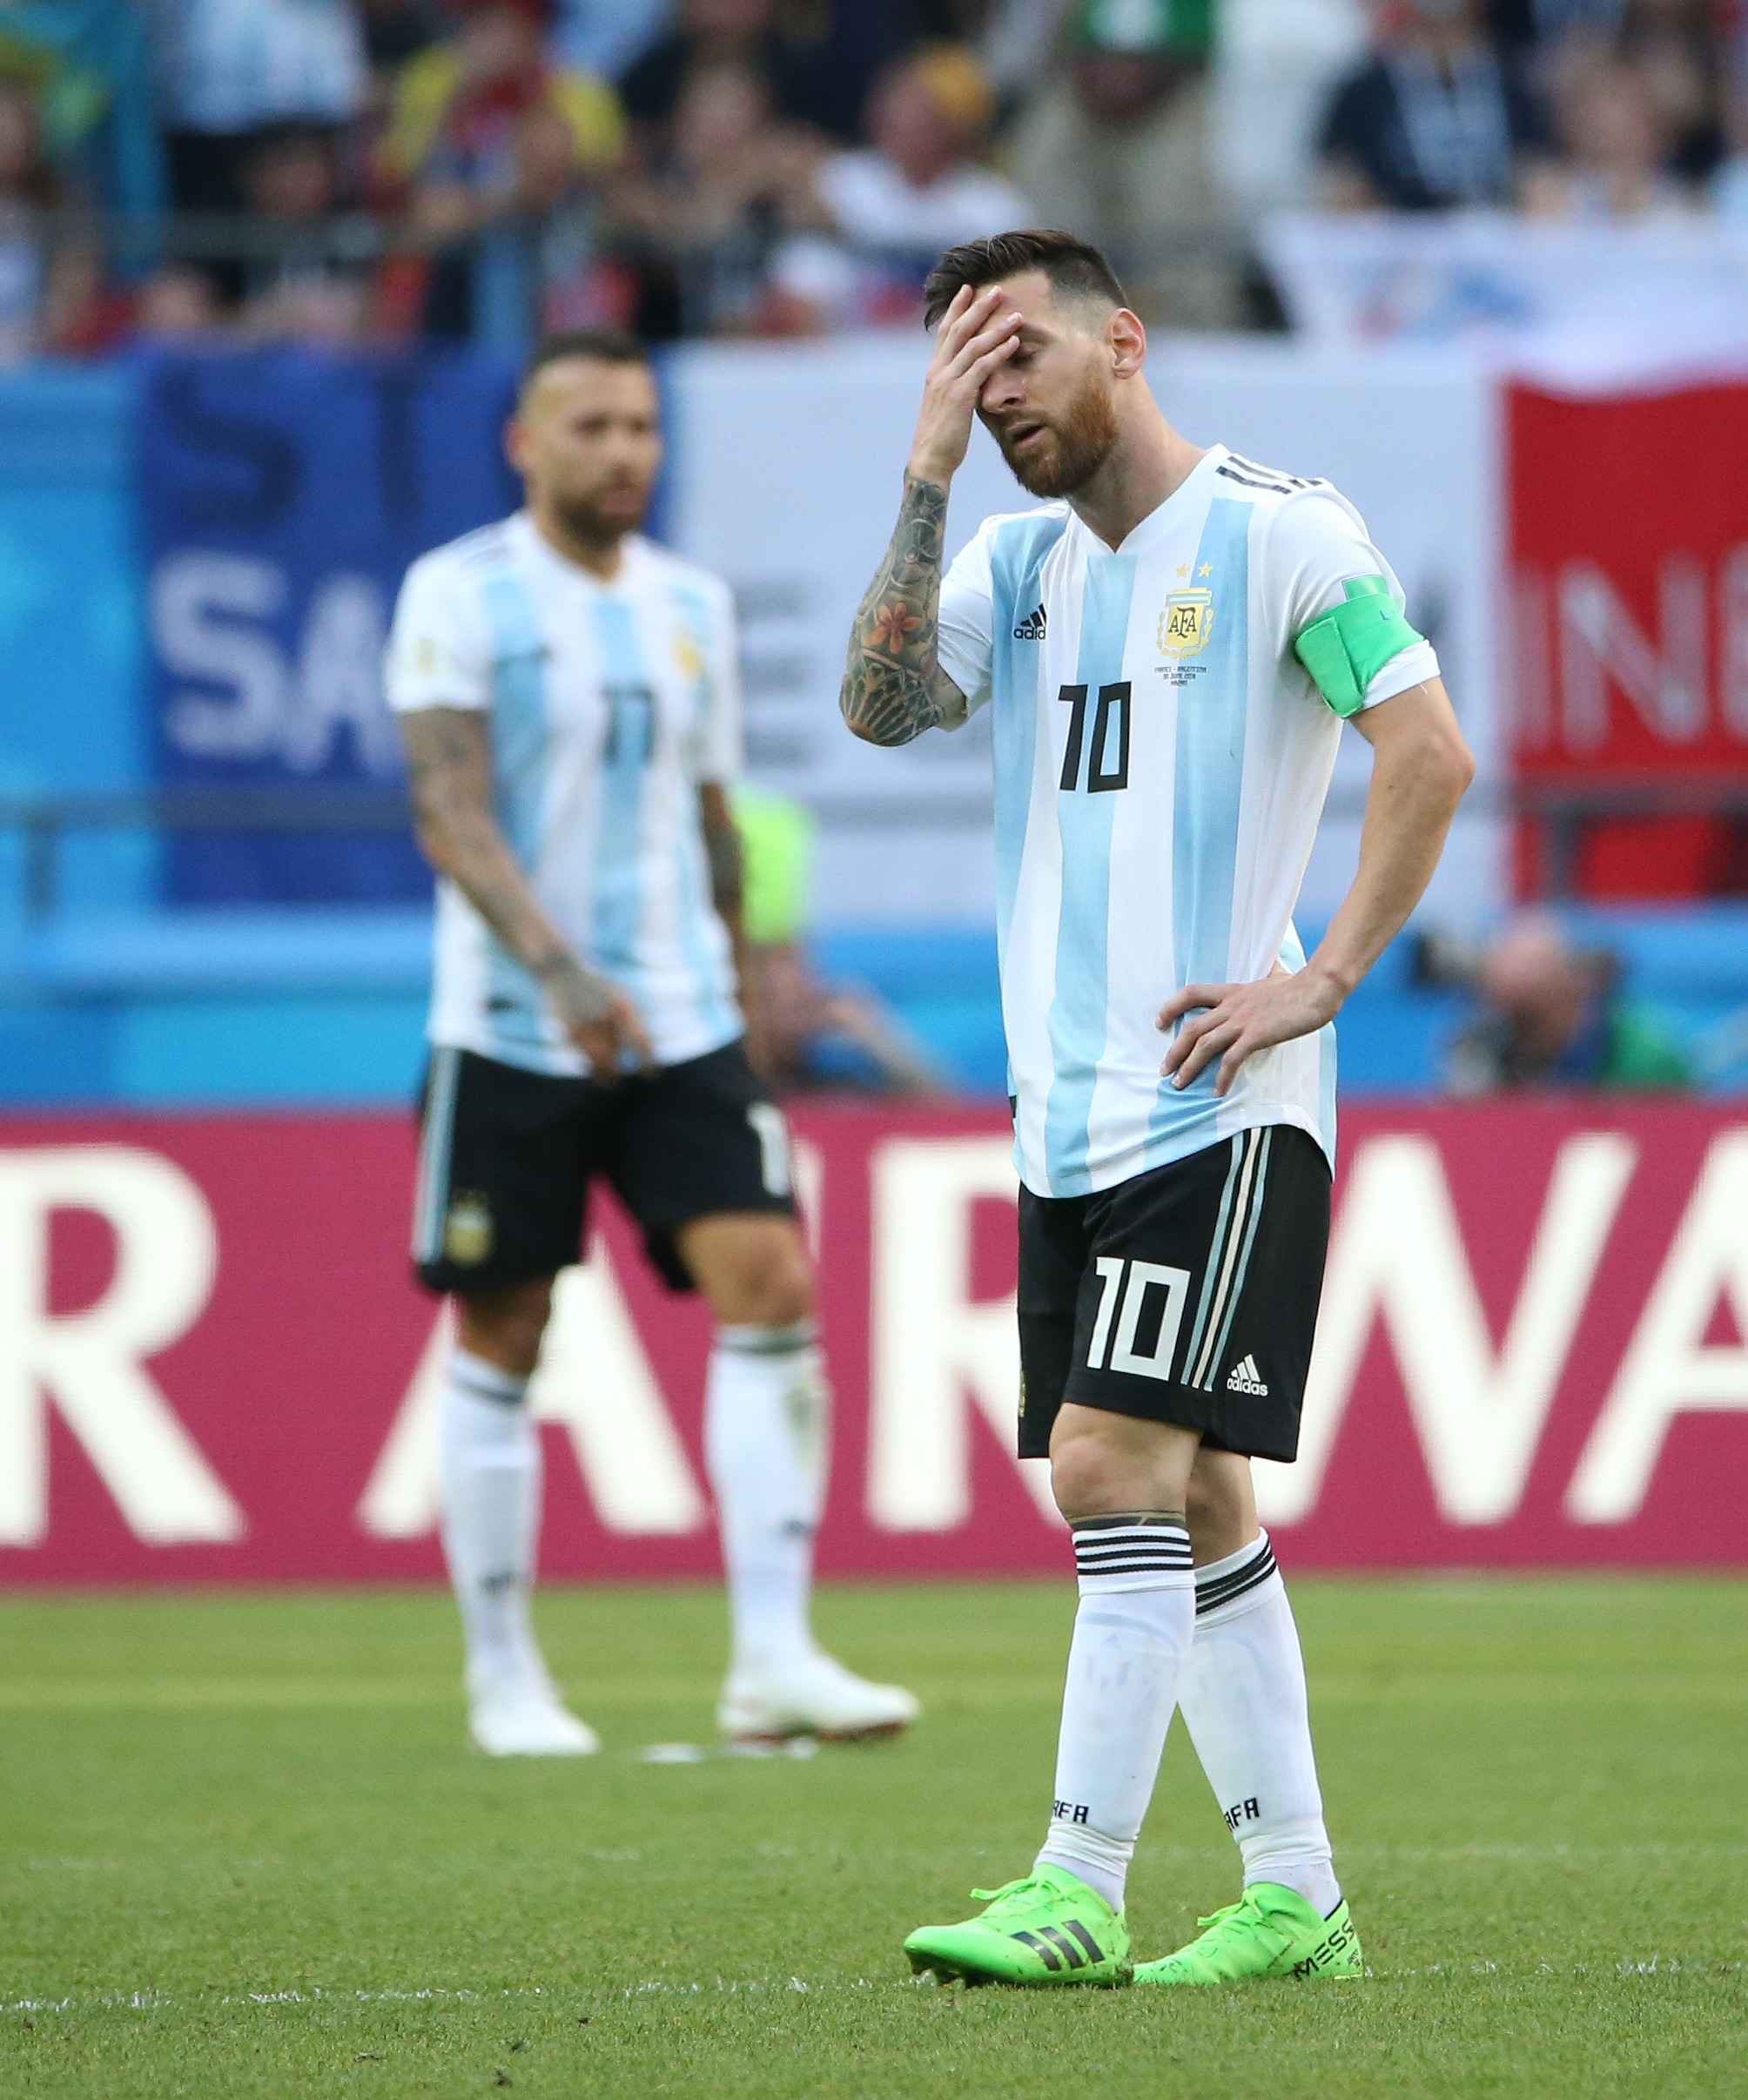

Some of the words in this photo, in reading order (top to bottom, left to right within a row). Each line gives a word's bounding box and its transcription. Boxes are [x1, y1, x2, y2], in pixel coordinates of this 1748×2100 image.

[1168, 607, 1197, 638] AFA
[1058, 681, 1132, 793] 10
[1087, 1256, 1191, 1381] 10
[1227, 1376, 1268, 1397] adidas
